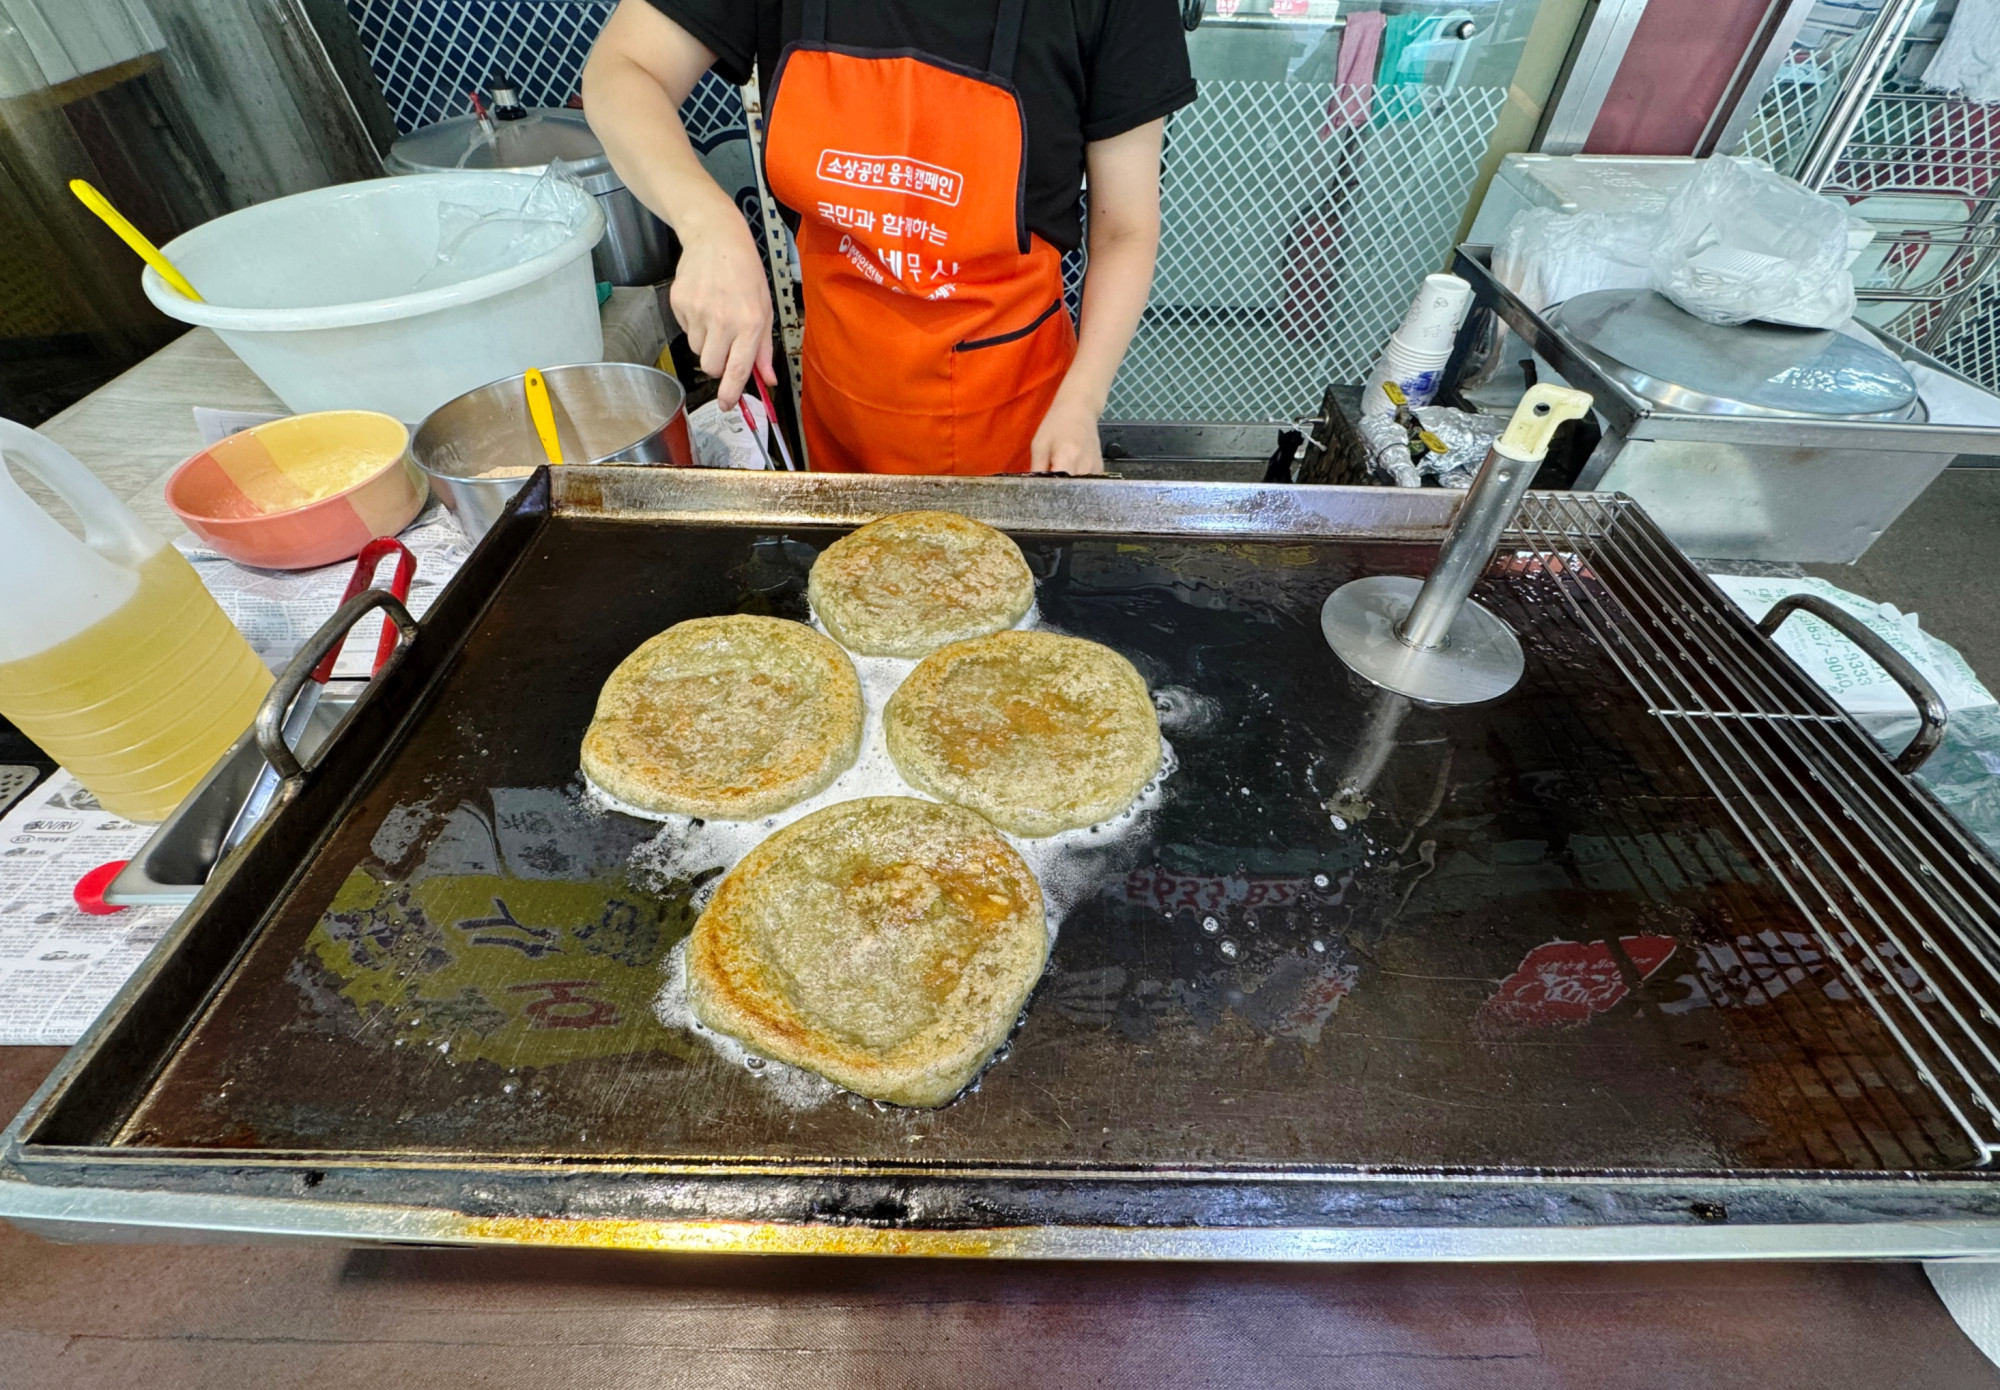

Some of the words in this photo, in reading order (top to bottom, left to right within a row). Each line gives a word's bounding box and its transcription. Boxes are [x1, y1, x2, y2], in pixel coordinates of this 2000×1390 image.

[826, 157, 885, 183] 소상공인
[817, 201, 876, 232] 국민과
[881, 212, 948, 246] 함께하는
